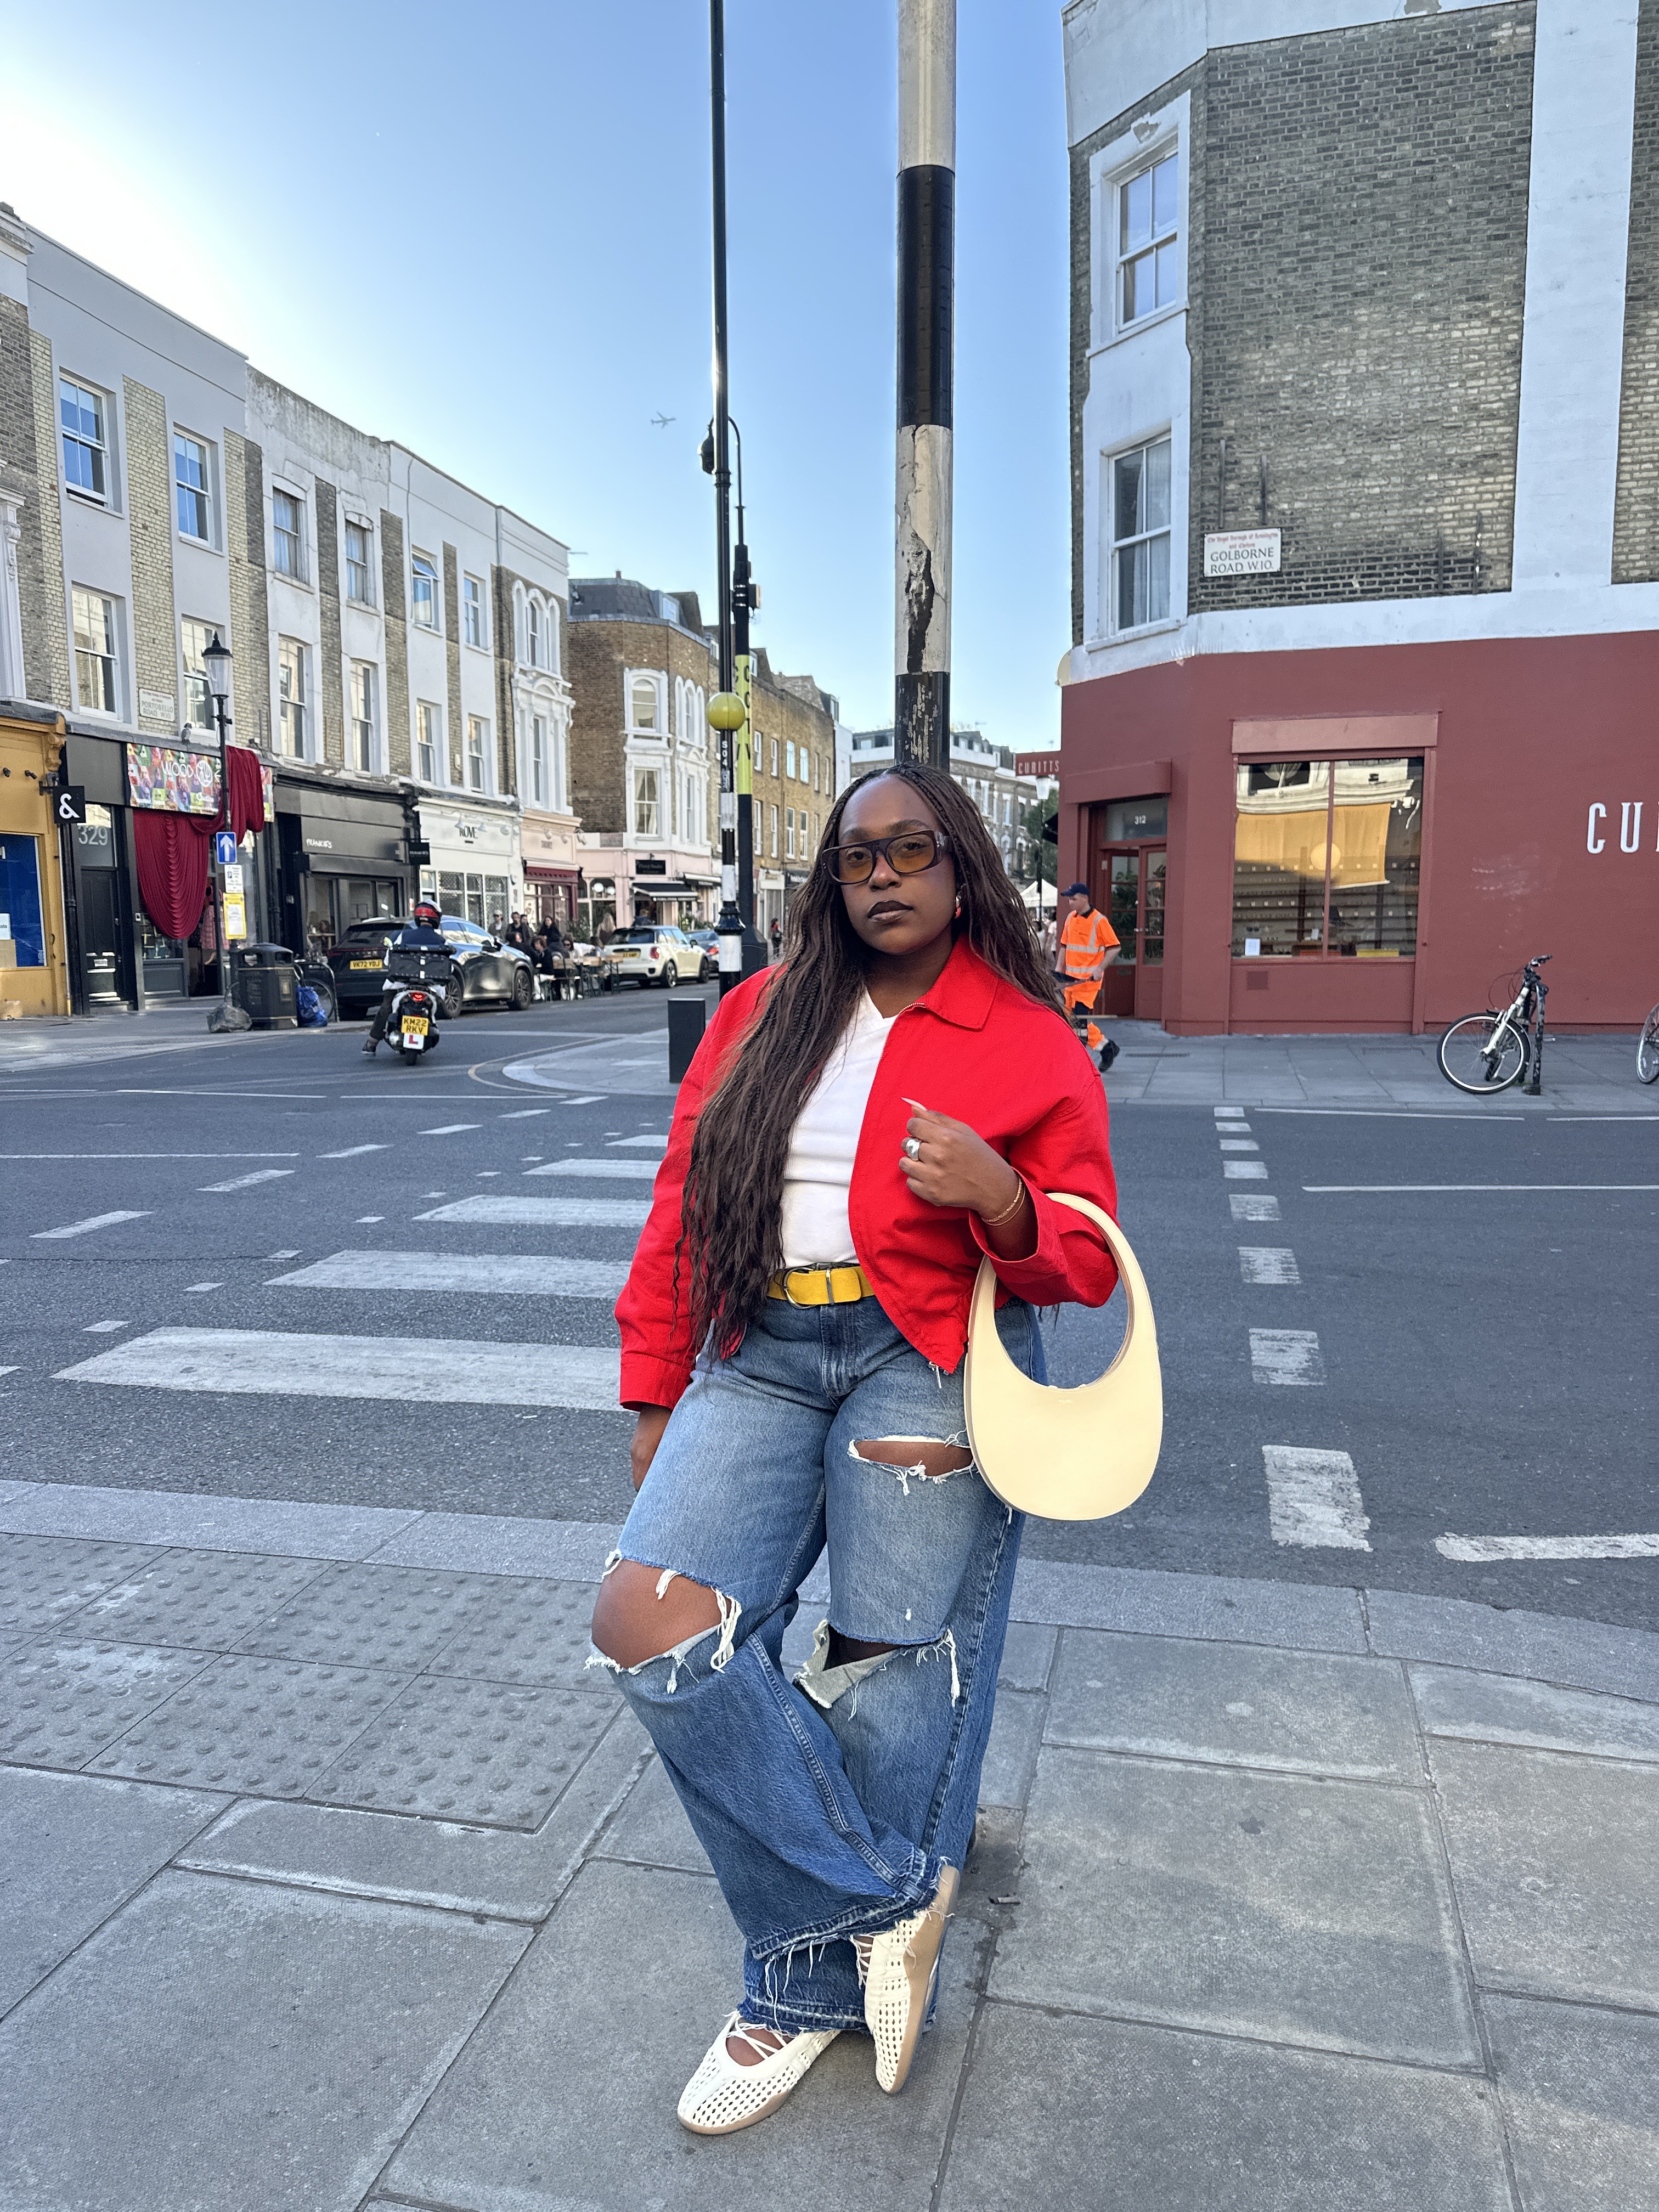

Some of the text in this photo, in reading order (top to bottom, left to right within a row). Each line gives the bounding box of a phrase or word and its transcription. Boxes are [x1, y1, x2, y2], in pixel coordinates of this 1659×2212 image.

[1211, 547, 1274, 562] GOLBORNE
[142, 701, 173, 713] PORTOBELLO
[143, 708, 157, 716] ROAD
[161, 760, 194, 778] WOOD
[1018, 760, 1059, 774] CUBITTS
[1135, 815, 1146, 825] 312
[459, 825, 478, 839] ROVE
[1587, 802, 1659, 854] CU
[78, 825, 108, 846] 329
[404, 1017, 427, 1028] KM22
[406, 1024, 424, 1034] RKV
[408, 1035, 419, 1045] L
